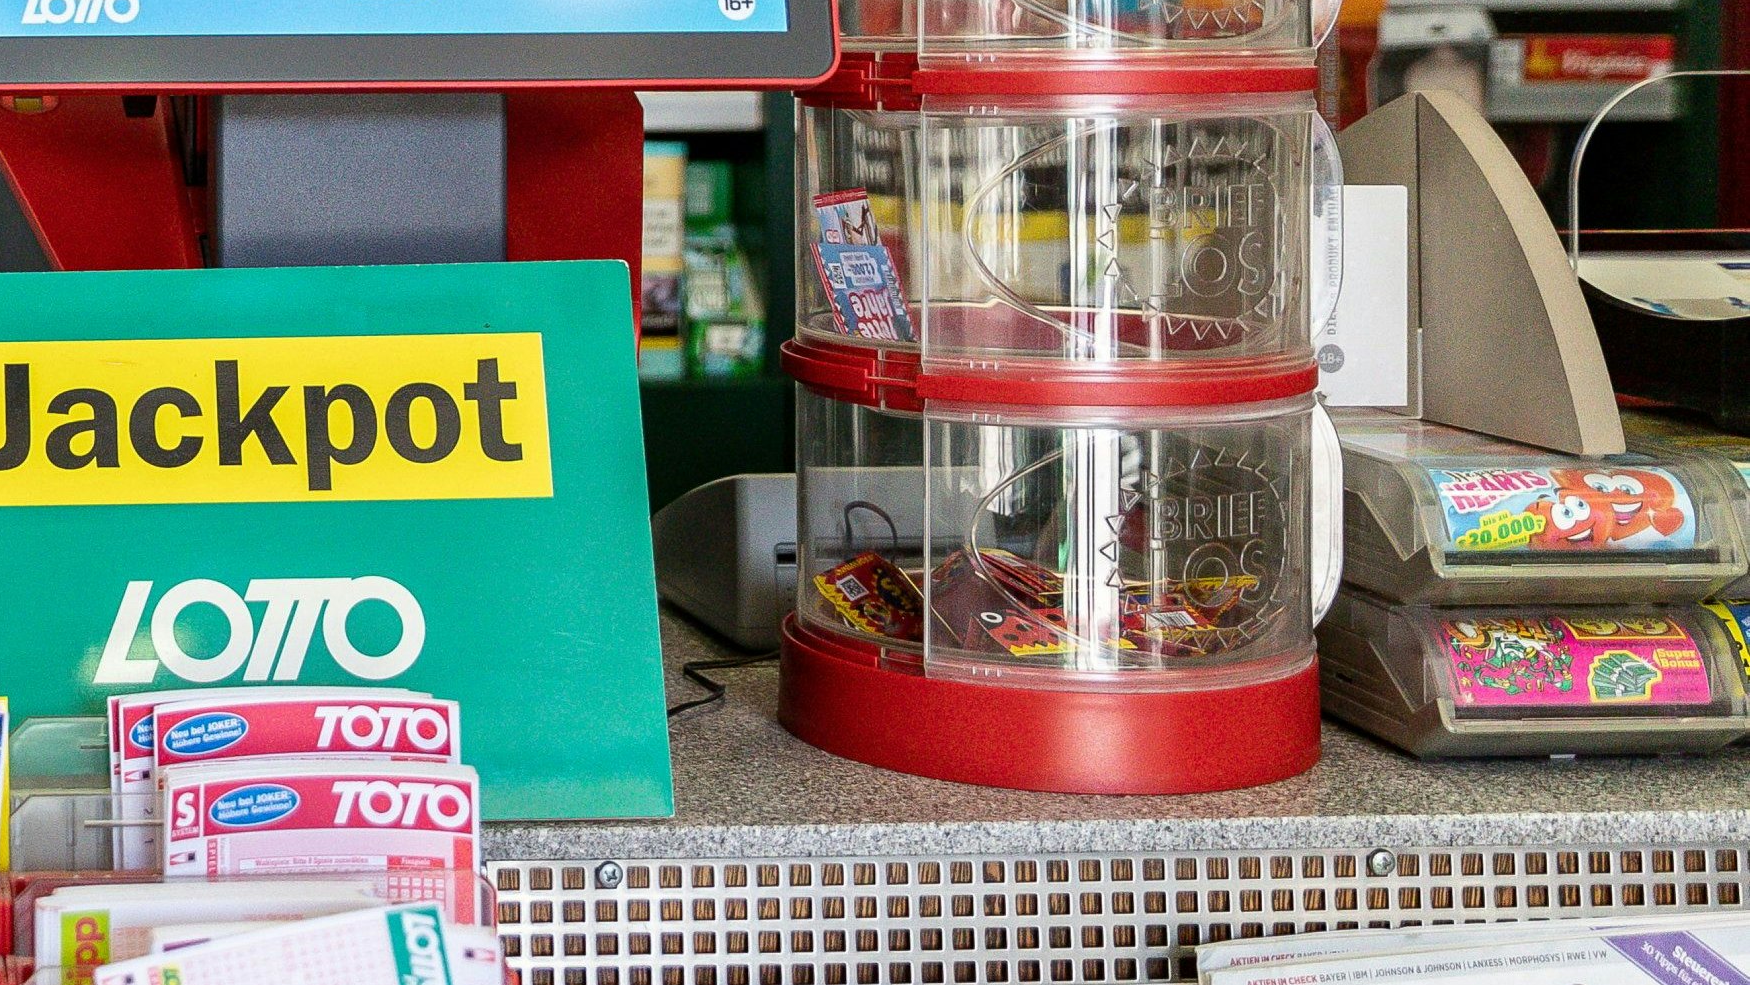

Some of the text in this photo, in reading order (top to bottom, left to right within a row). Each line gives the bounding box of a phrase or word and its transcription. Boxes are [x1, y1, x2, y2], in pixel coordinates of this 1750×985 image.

[1320, 352, 1342, 365] 18+
[1153, 490, 1265, 540] BRIEF
[93, 575, 425, 684] LOTTO
[314, 704, 449, 750] TOTO
[174, 792, 196, 827] S
[331, 780, 470, 829] TOTO
[171, 826, 200, 838] SYSTEM
[1230, 955, 1260, 966] AKTIEN
[1288, 975, 1319, 985] CHECK
[1319, 972, 1346, 983] BAYER
[1353, 970, 1369, 980] IBM
[1374, 966, 1414, 978] JOHNSON
[1423, 962, 1462, 974] JOHNSON
[1467, 957, 1504, 968] LANXESS
[1508, 953, 1561, 966] MORPHOSYS
[1566, 951, 1586, 962] RWE
[1592, 950, 1607, 959] VW
